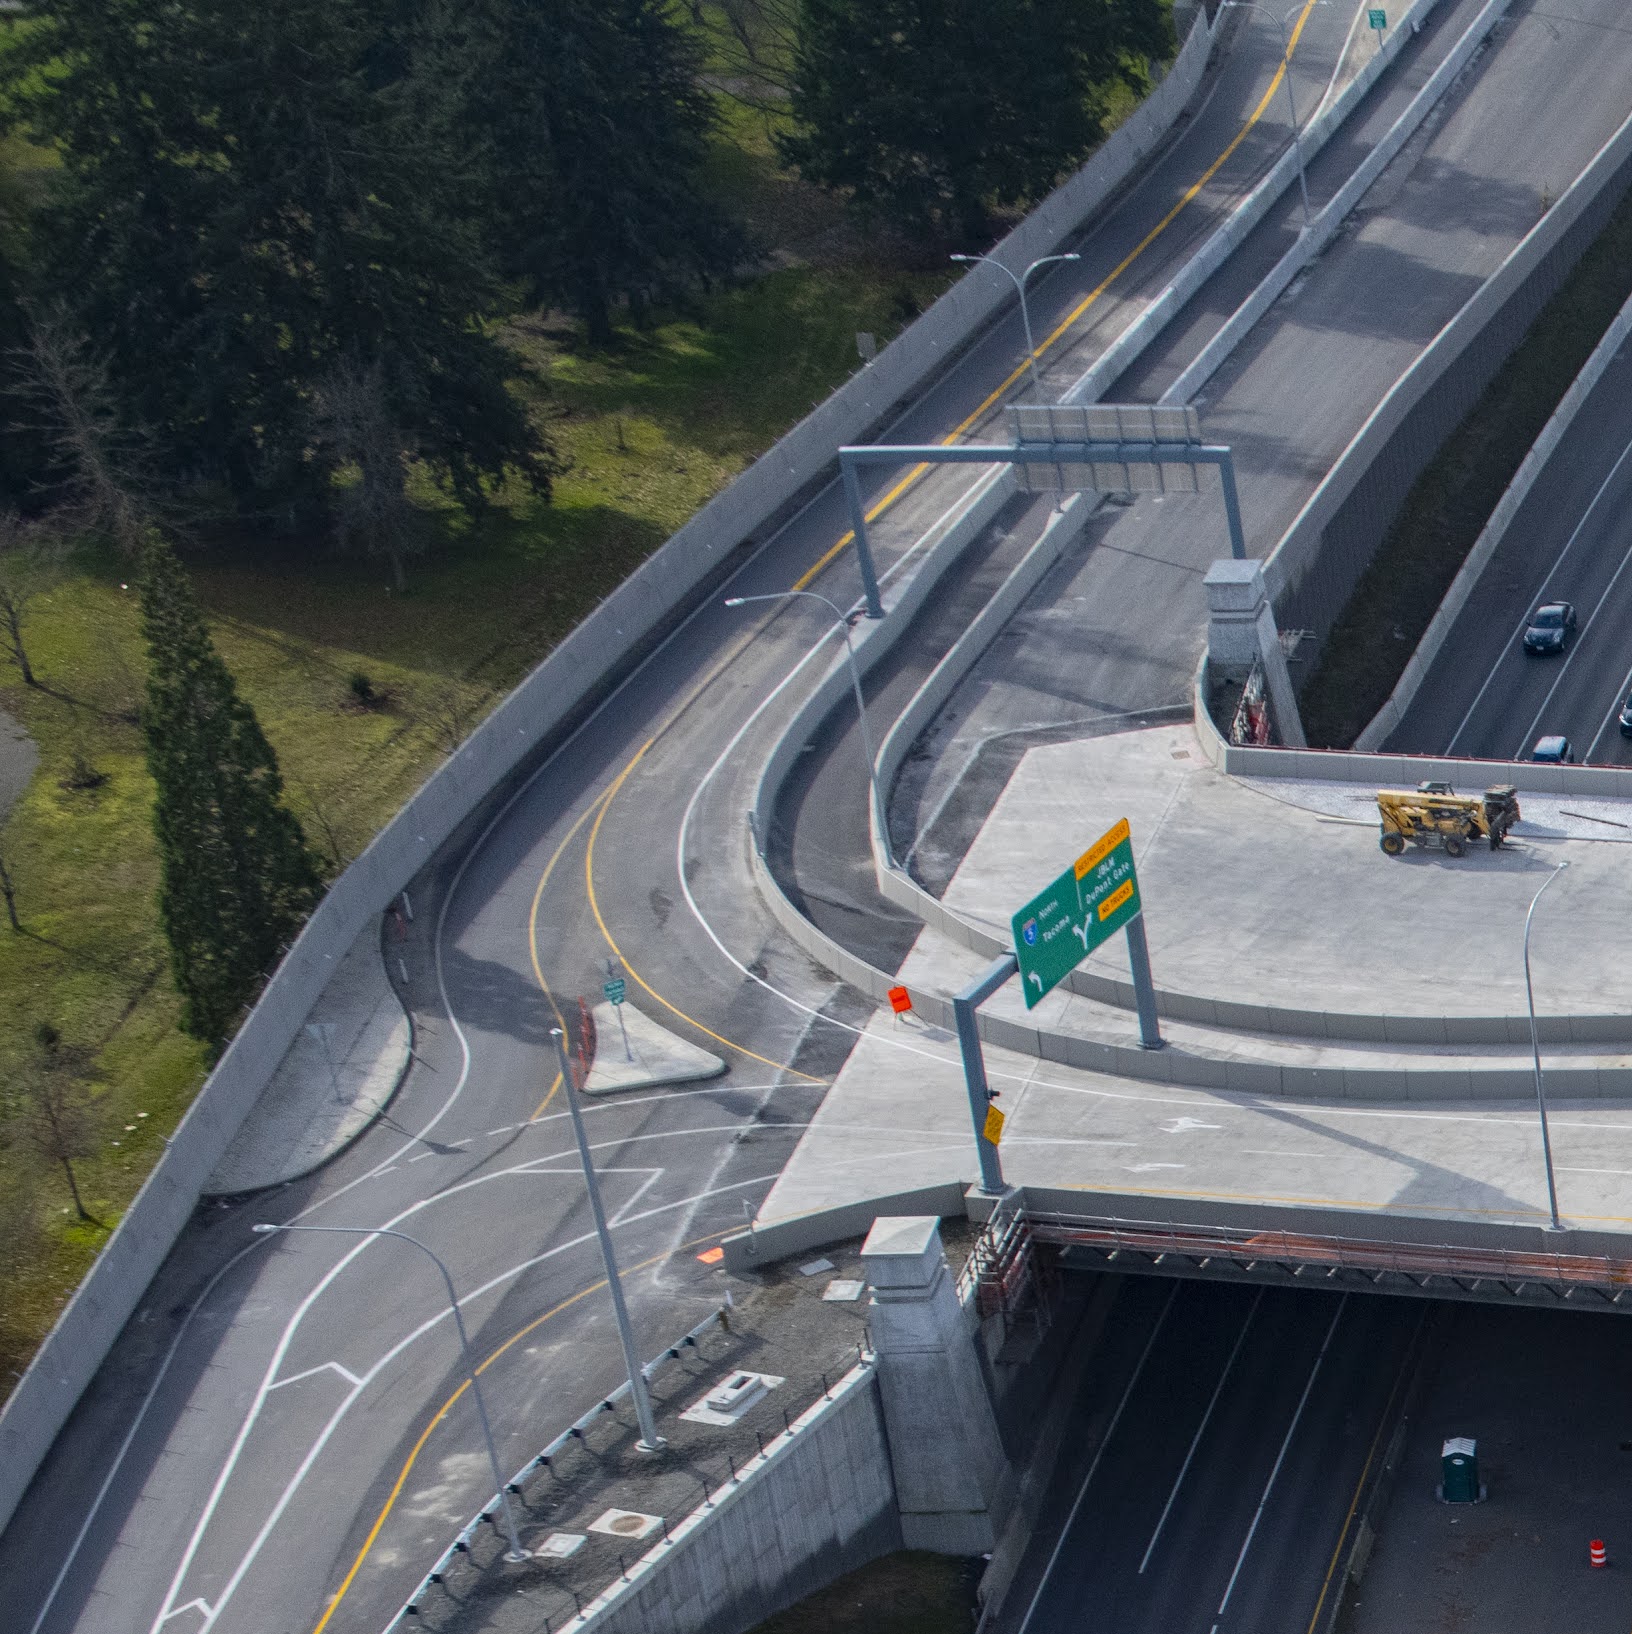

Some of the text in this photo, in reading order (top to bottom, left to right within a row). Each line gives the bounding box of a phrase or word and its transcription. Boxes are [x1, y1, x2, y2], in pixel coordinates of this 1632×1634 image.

[1078, 844, 1105, 871] RESTRICTED
[1097, 856, 1115, 878] JBLM
[1086, 862, 1129, 904] DuPont Gate
[1102, 886, 1130, 913] NO TRUCKS
[1043, 915, 1070, 942] Tacoma
